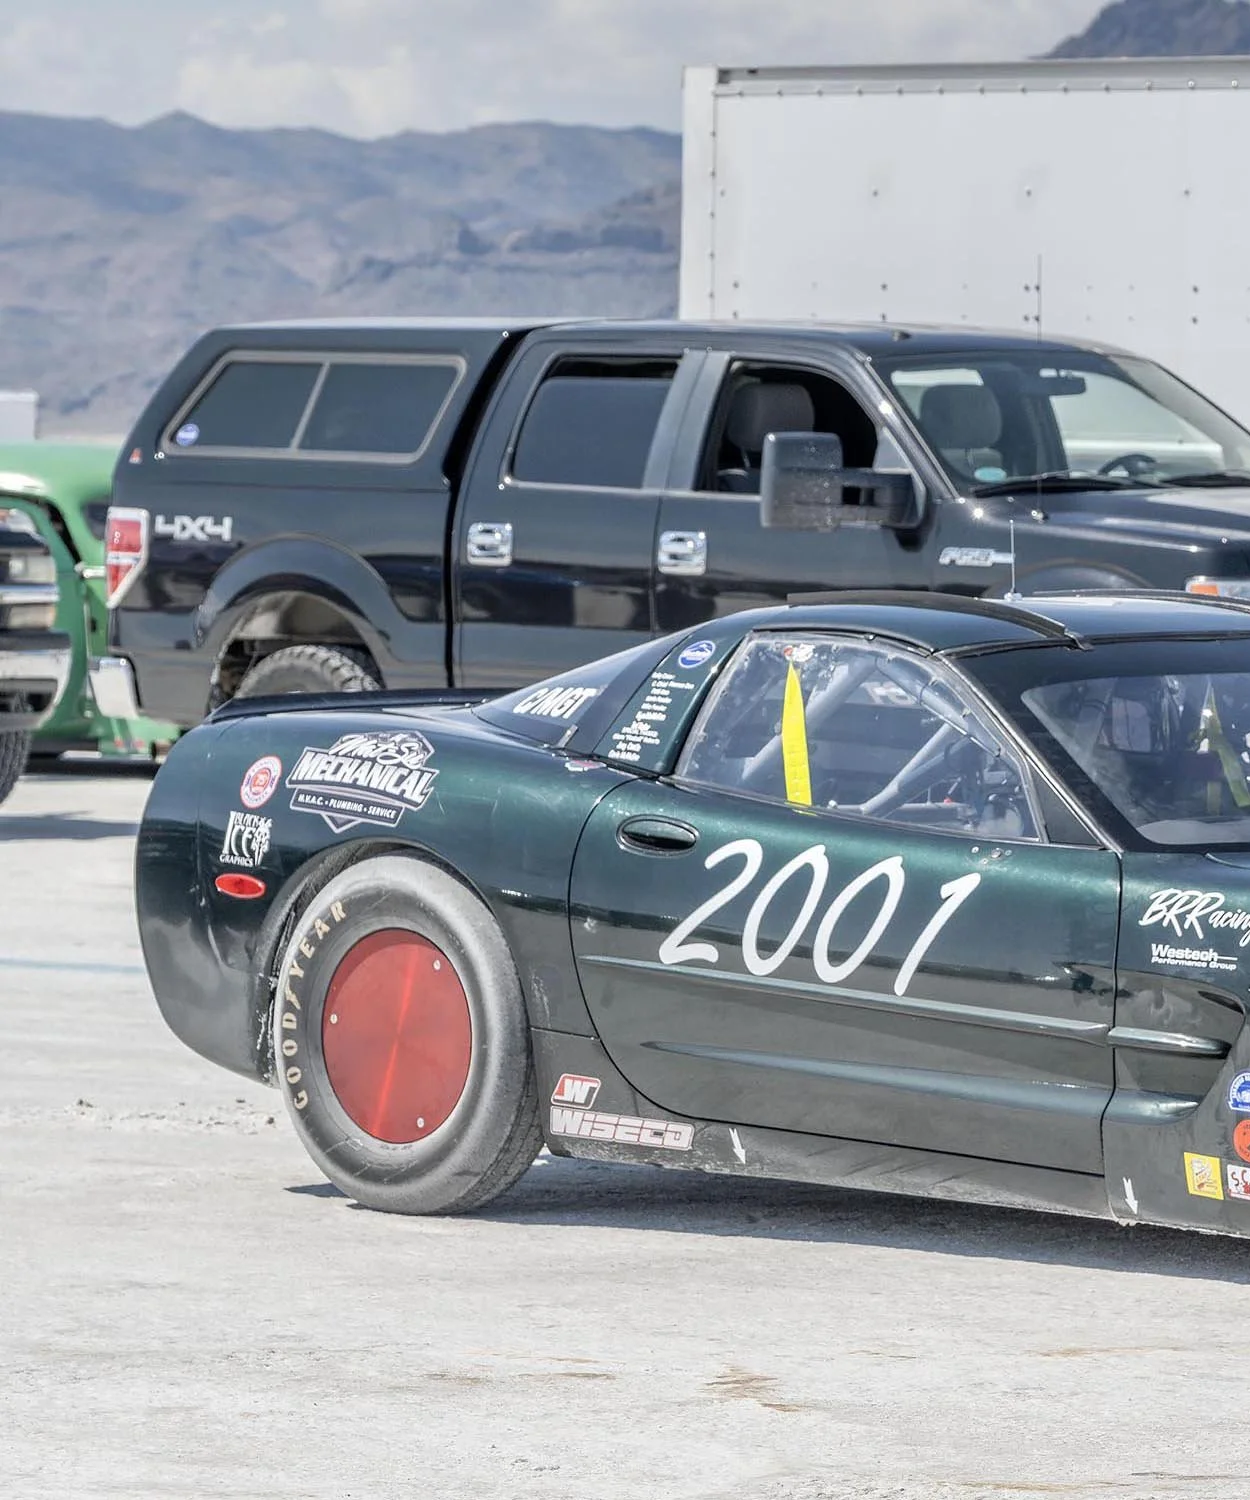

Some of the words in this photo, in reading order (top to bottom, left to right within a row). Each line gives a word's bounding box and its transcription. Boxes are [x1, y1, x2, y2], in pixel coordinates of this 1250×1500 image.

[291, 751, 433, 803] MECHANICAL
[328, 798, 363, 812] PLUMBING
[367, 805, 397, 819] SERVICE
[219, 854, 254, 868] GRAPHICS
[658, 838, 982, 997] 2001
[1151, 943, 1219, 962] Westech
[1151, 956, 1208, 969] Performance
[1209, 962, 1237, 972] Group
[281, 901, 347, 1110] GOODYEAR
